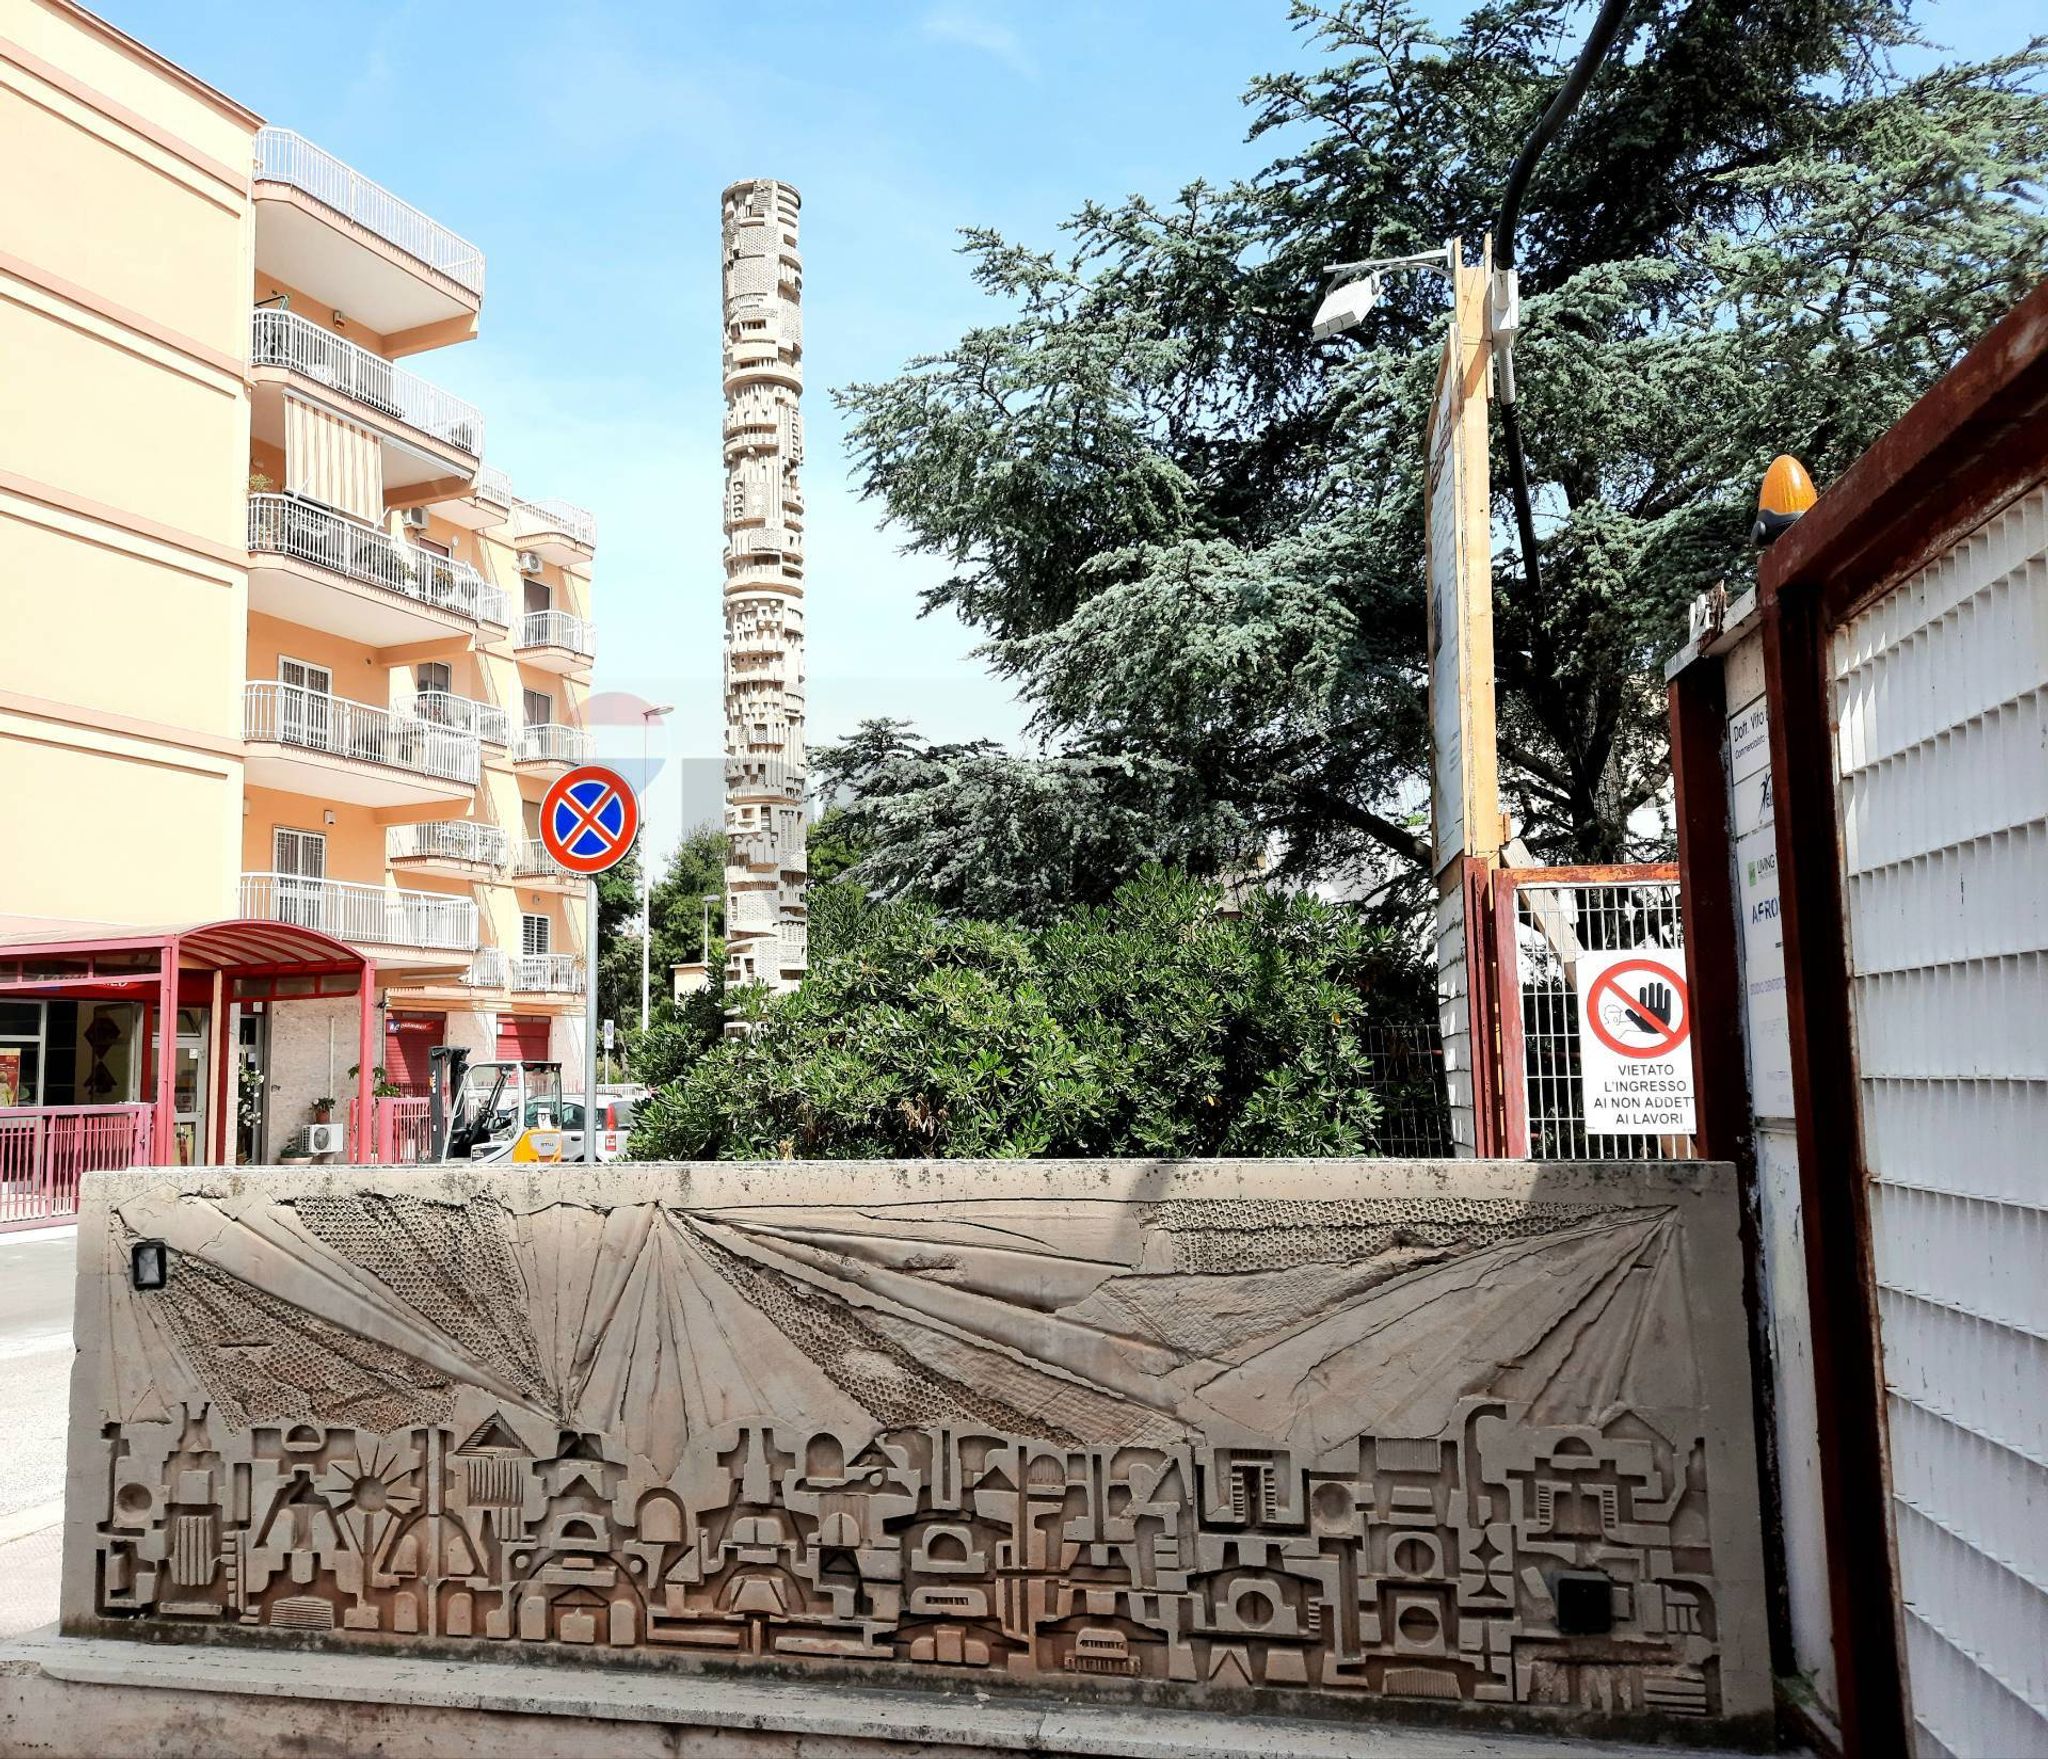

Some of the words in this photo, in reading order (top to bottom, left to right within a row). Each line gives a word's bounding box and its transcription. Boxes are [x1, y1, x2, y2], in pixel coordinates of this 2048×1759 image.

[1750, 709, 1764, 730] Vito
[1757, 854, 1775, 874] LIVING
[1618, 1064, 1674, 1076] VIETATO
[1604, 1080, 1687, 1092] L'INGRESSO
[1594, 1097, 1607, 1109] AI
[1611, 1097, 1640, 1108] NON
[1616, 1113, 1629, 1124] AI
[1633, 1113, 1683, 1124] LAVORI
